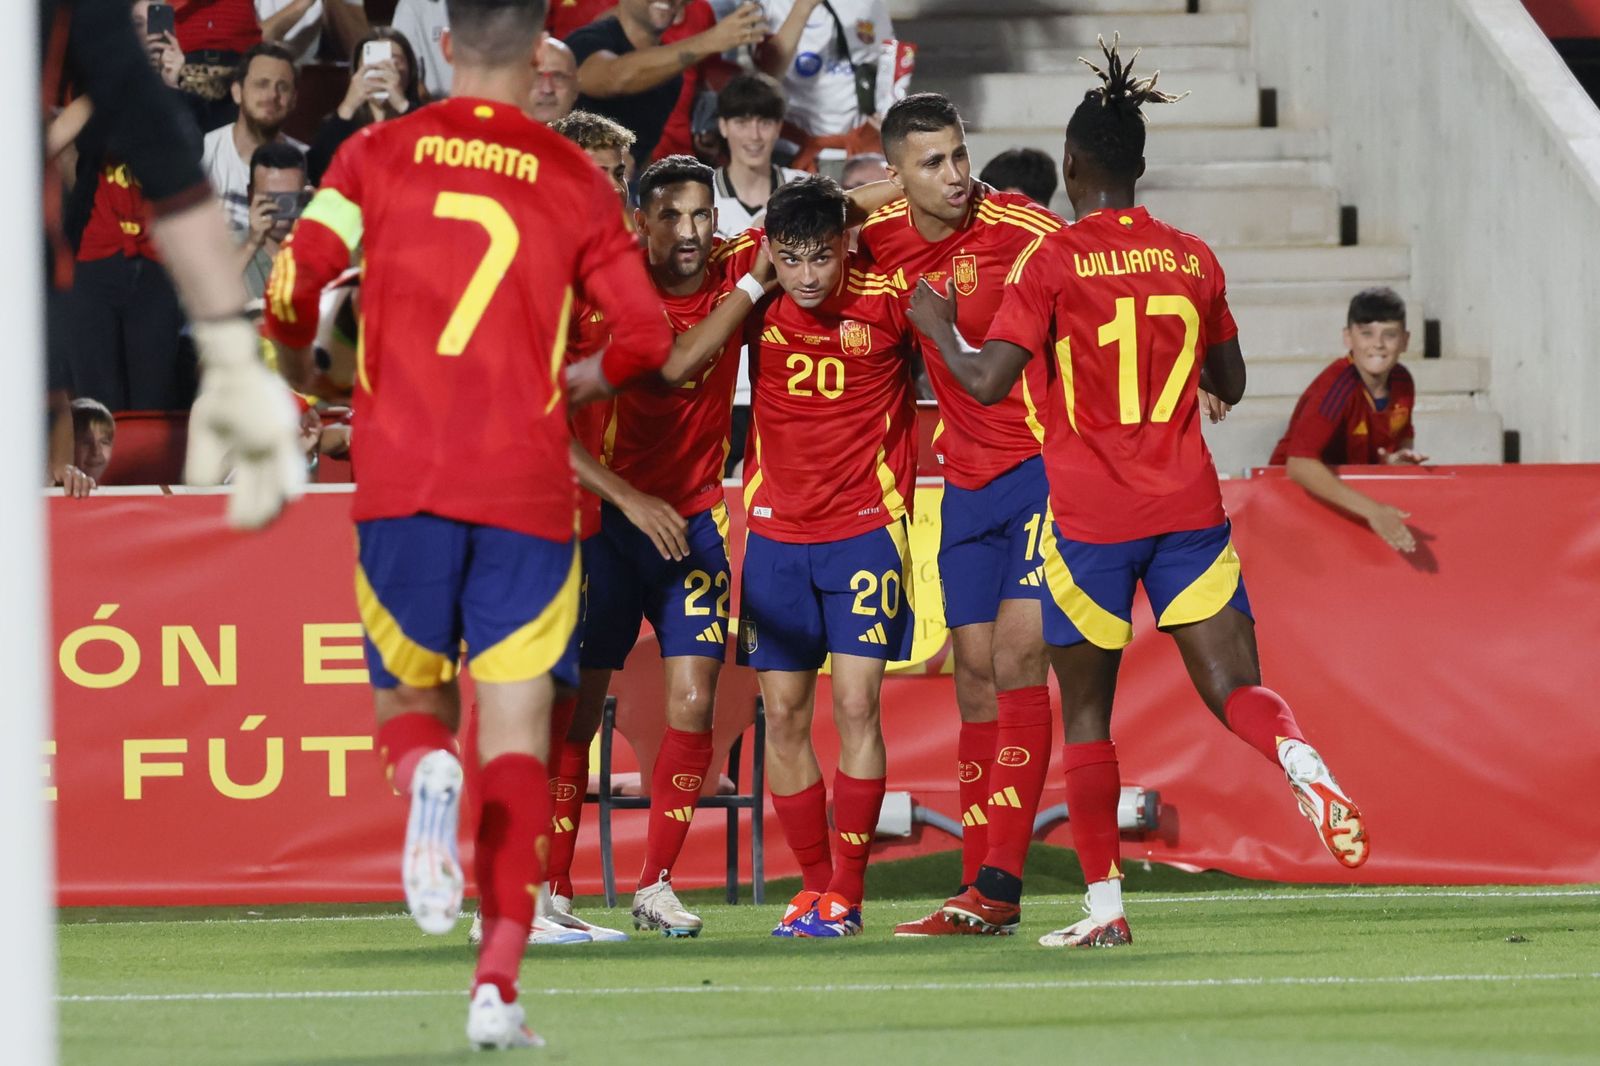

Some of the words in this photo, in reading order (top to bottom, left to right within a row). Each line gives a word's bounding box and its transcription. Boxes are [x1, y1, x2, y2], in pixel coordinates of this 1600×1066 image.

[414, 135, 539, 184] MORATA
[432, 191, 520, 356] 7
[1074, 248, 1177, 277] WILLIAMS
[1181, 252, 1206, 279] JR.
[786, 353, 845, 399] 20
[1098, 295, 1200, 425] 17
[1023, 513, 1046, 560] 1
[684, 569, 730, 618] 22
[850, 569, 900, 620] 20
[58, 603, 238, 689] ÓN
[123, 715, 400, 800] FÚT
